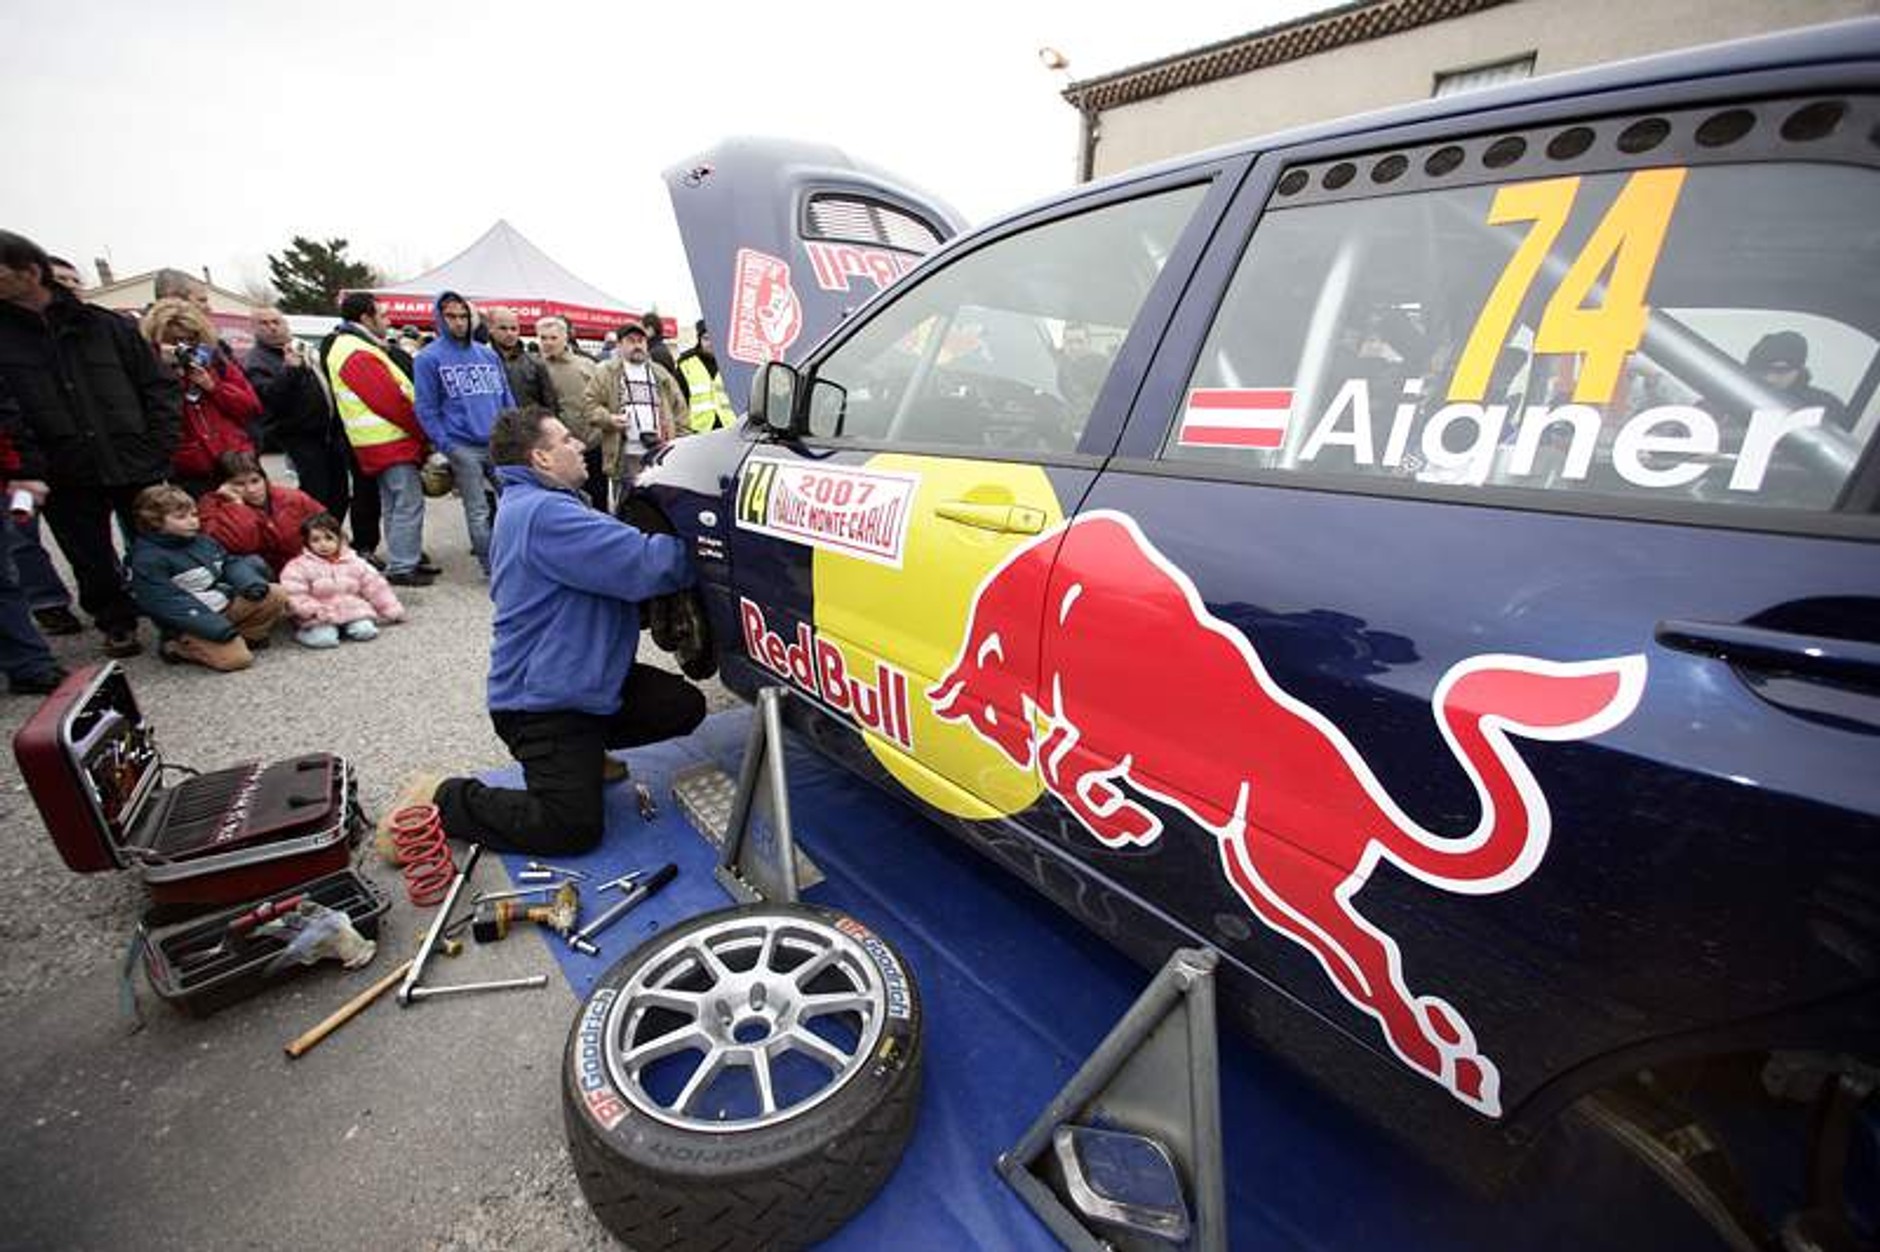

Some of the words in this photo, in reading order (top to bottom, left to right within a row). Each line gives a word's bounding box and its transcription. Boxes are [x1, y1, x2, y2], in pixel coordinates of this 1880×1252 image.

[1445, 167, 1686, 403] 74
[1299, 379, 1825, 492] Aigner
[742, 463, 778, 526] 74
[775, 478, 807, 527] RALLYE
[799, 475, 876, 506] 2007
[740, 597, 821, 698] Red
[815, 634, 914, 752] Bull
